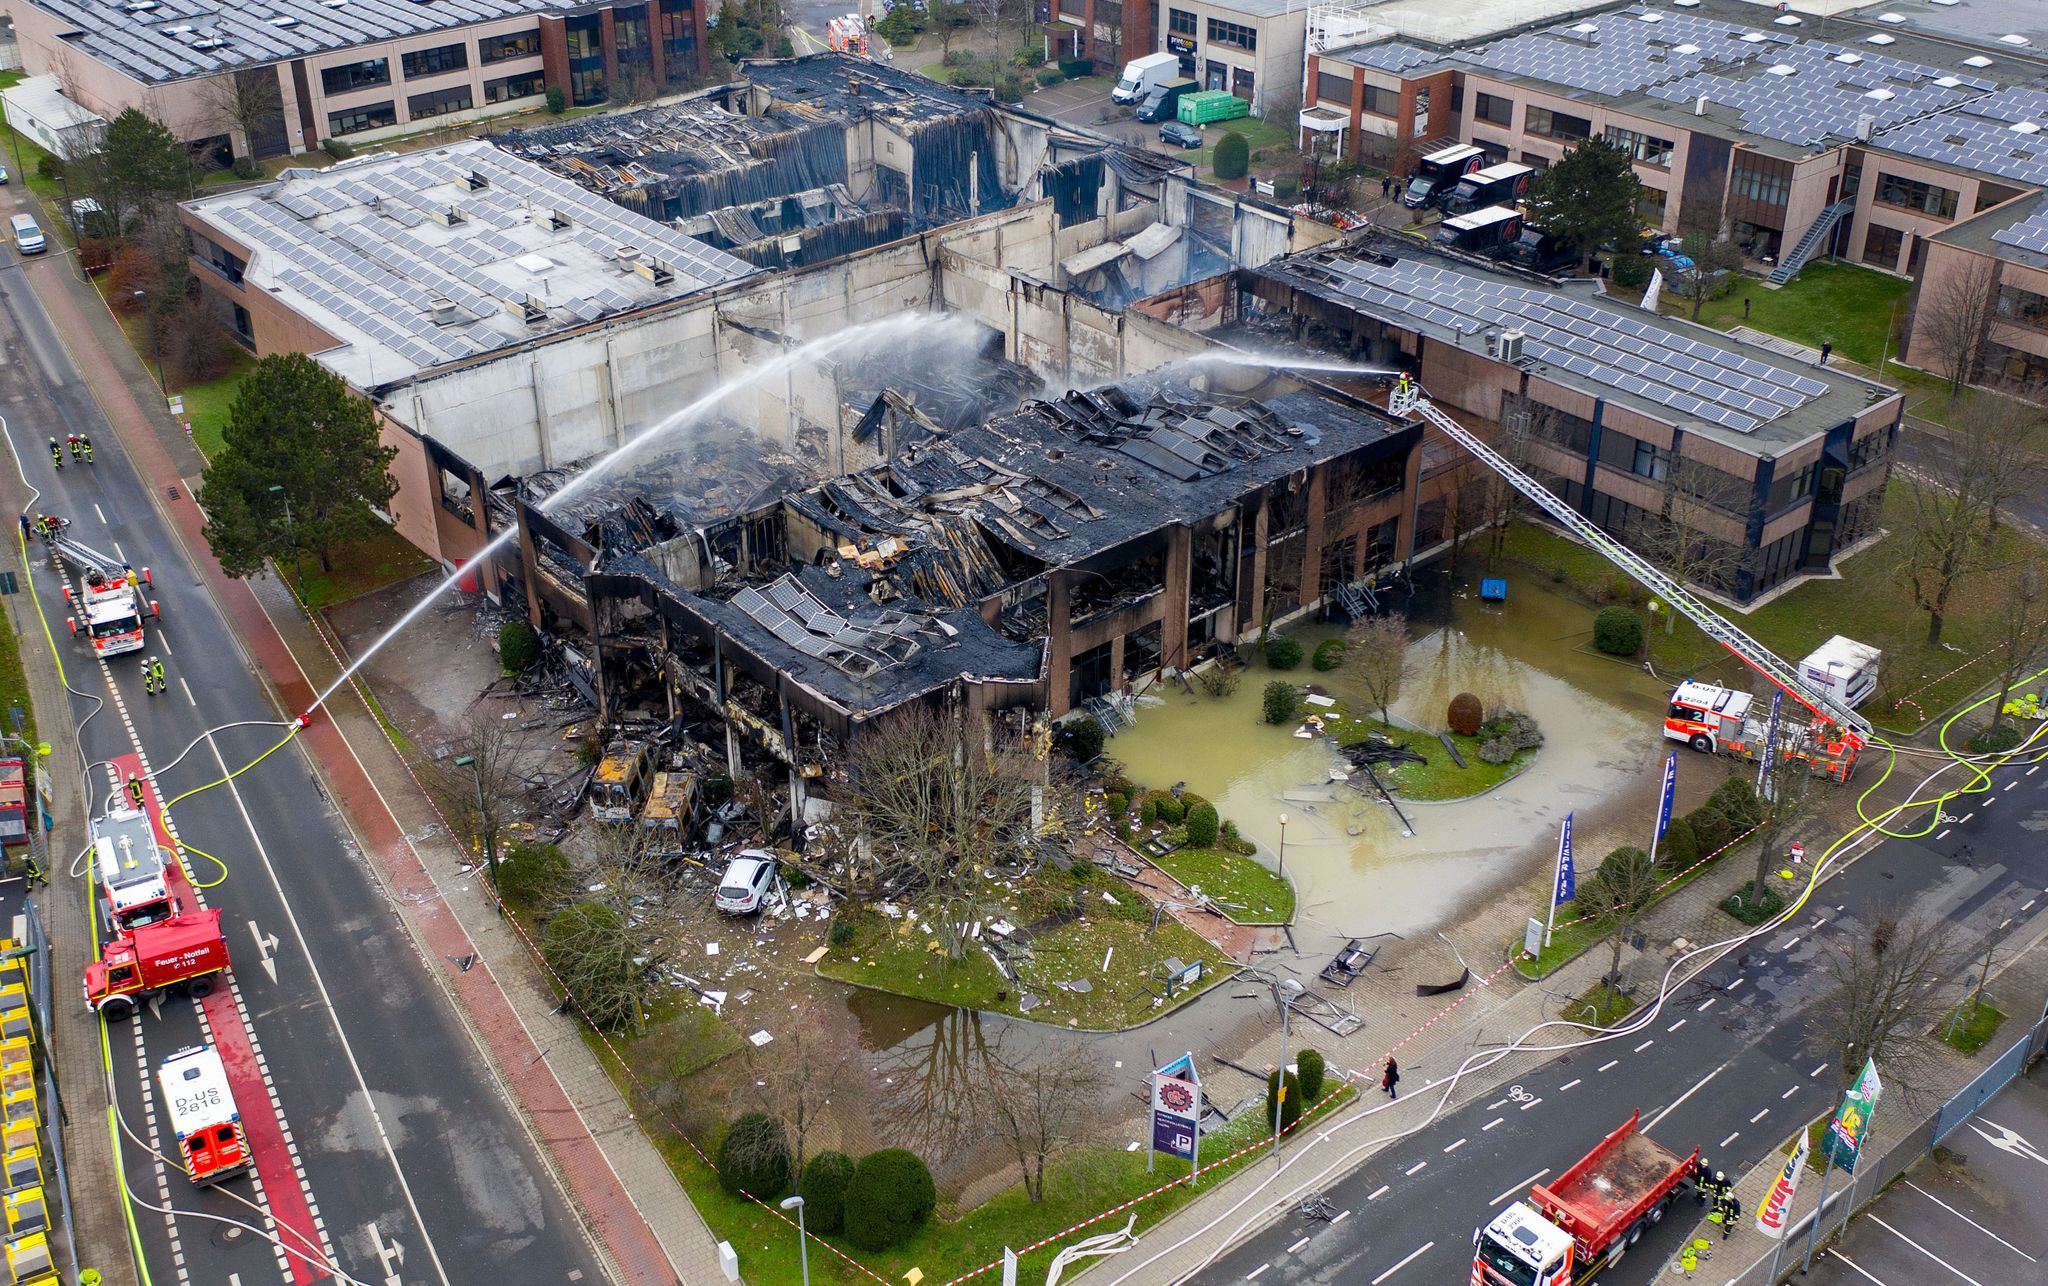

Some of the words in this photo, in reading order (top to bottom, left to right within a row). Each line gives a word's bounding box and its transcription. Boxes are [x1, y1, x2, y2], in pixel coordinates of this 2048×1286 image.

[1692, 684, 1717, 692] D-US
[1683, 696, 1709, 705] 2204
[1692, 711, 1703, 721] 2
[155, 955, 178, 967] Feuer
[184, 947, 210, 960] Notfall
[181, 958, 196, 967] 112
[175, 1087, 219, 1108] D-US
[178, 1096, 221, 1116] 2816
[1179, 1136, 1189, 1147] P
